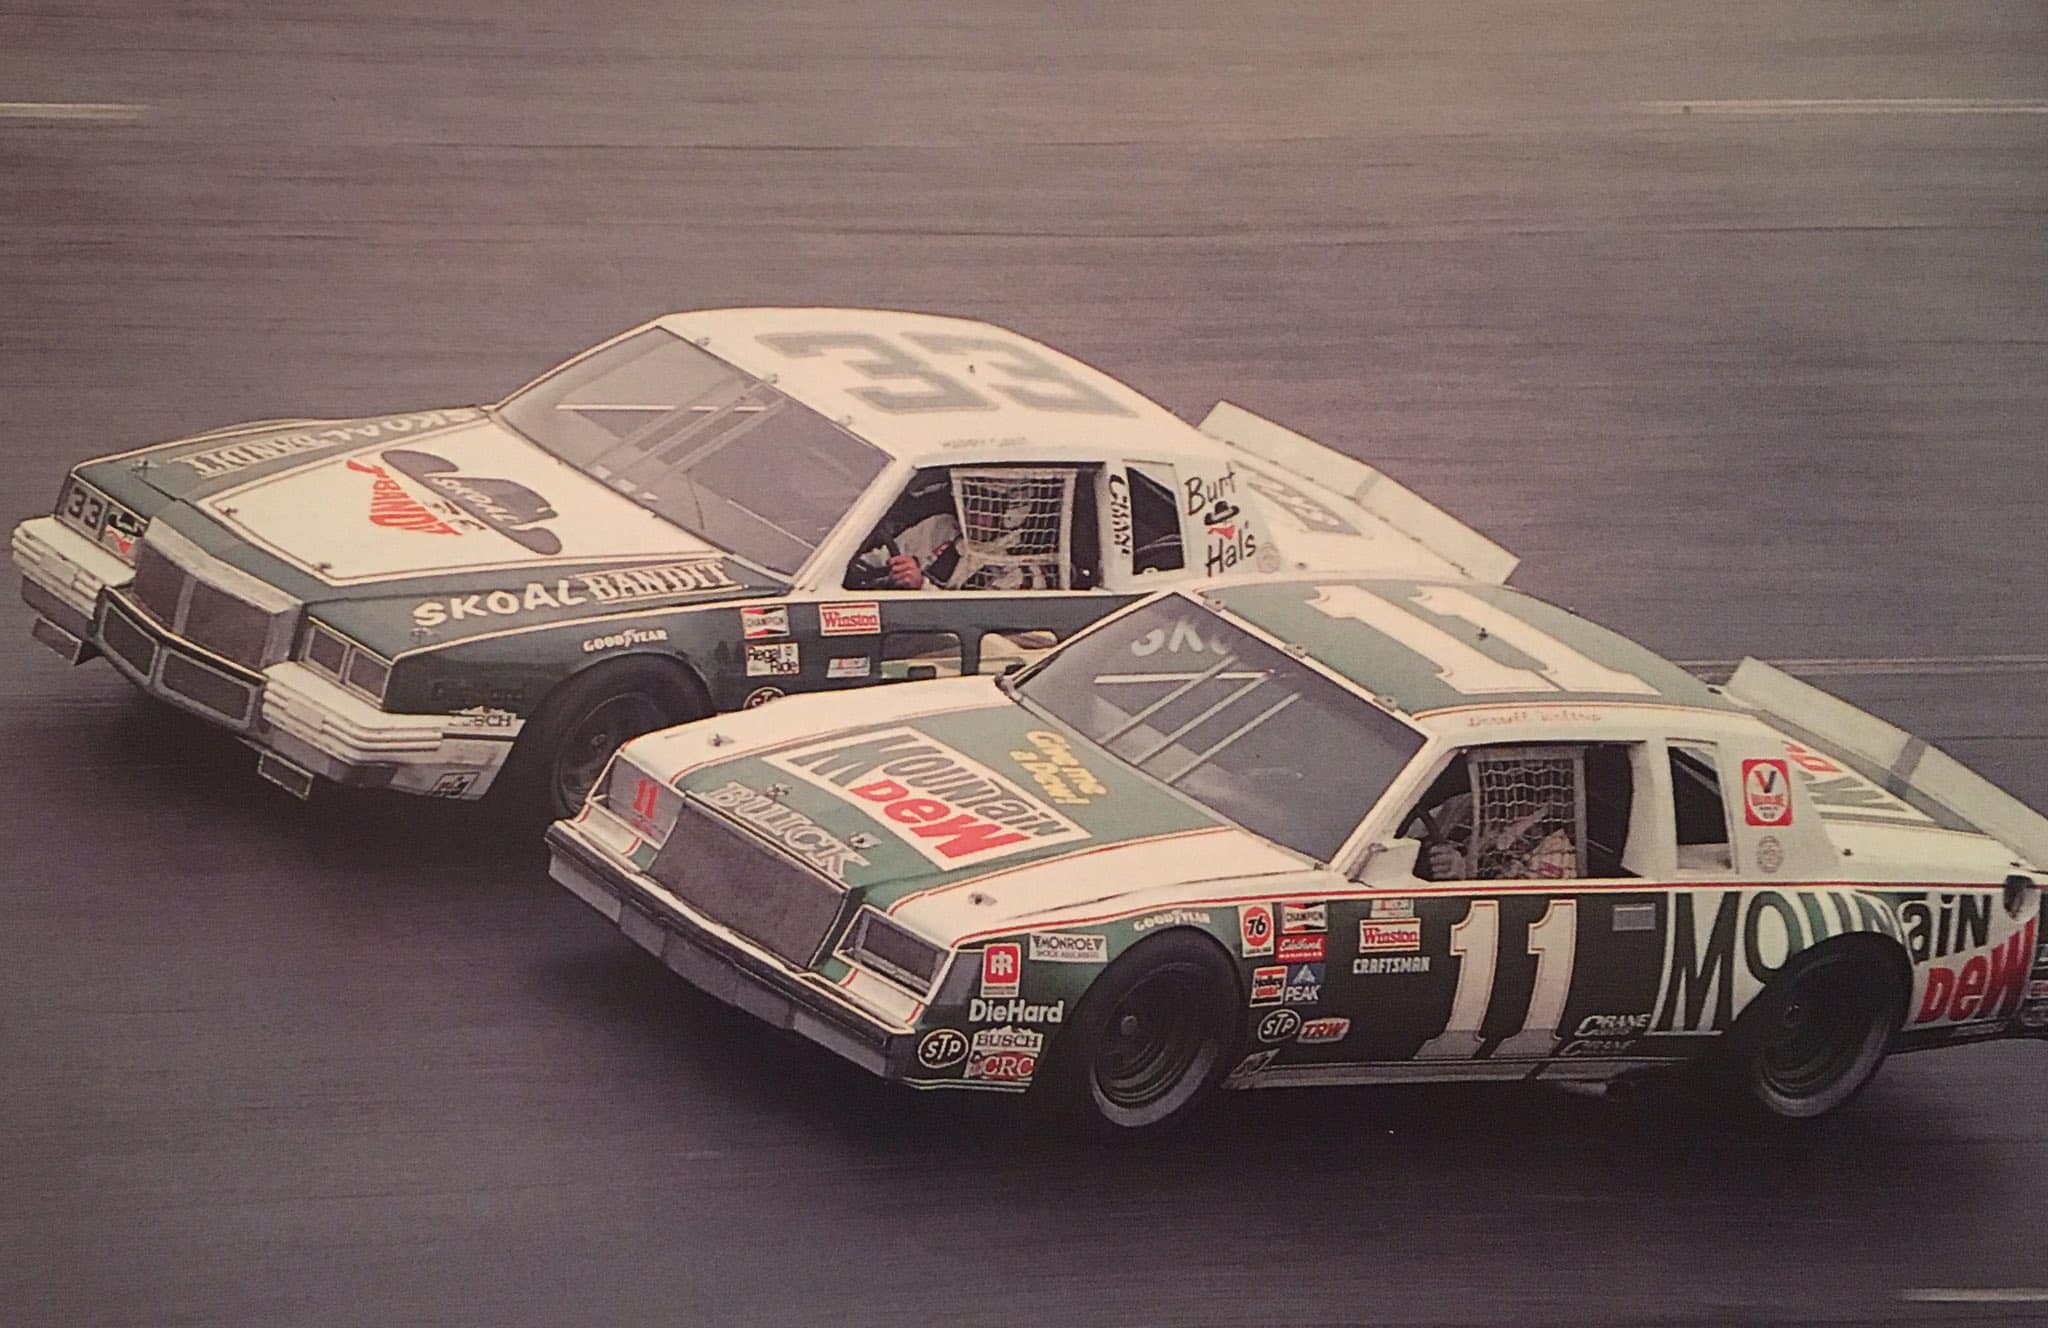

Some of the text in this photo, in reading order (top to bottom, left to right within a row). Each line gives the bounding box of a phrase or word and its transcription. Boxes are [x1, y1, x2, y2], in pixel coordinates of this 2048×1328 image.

[755, 331, 1139, 418] 33
[1183, 462, 1237, 517] Burt
[67, 486, 103, 530] 33
[1205, 521, 1257, 577] Hal's
[412, 559, 744, 627] SKOAL BANDIT
[821, 610, 879, 629] Winston
[582, 628, 669, 653] GOODYEAR
[1303, 584, 1662, 696] 11
[632, 778, 659, 820] 11
[702, 780, 871, 880] BUICK
[1133, 908, 1212, 932] GOODYEAR
[1247, 915, 1267, 937] 76
[1285, 910, 1324, 923] CHAMPION
[1041, 935, 1095, 951] MONROE
[1362, 927, 1418, 945] Winston
[1352, 955, 1432, 975] CRAFTSMAN
[1411, 899, 1578, 1060] 11
[1284, 984, 1322, 1002] PEAK
[968, 998, 1065, 1024] DieHard
[1262, 1012, 1296, 1037] STP
[1303, 1021, 1347, 1040] TRW
[925, 1033, 962, 1060] STP
[975, 1033, 1039, 1048] BUSCH
[982, 1055, 1035, 1077] CRC
